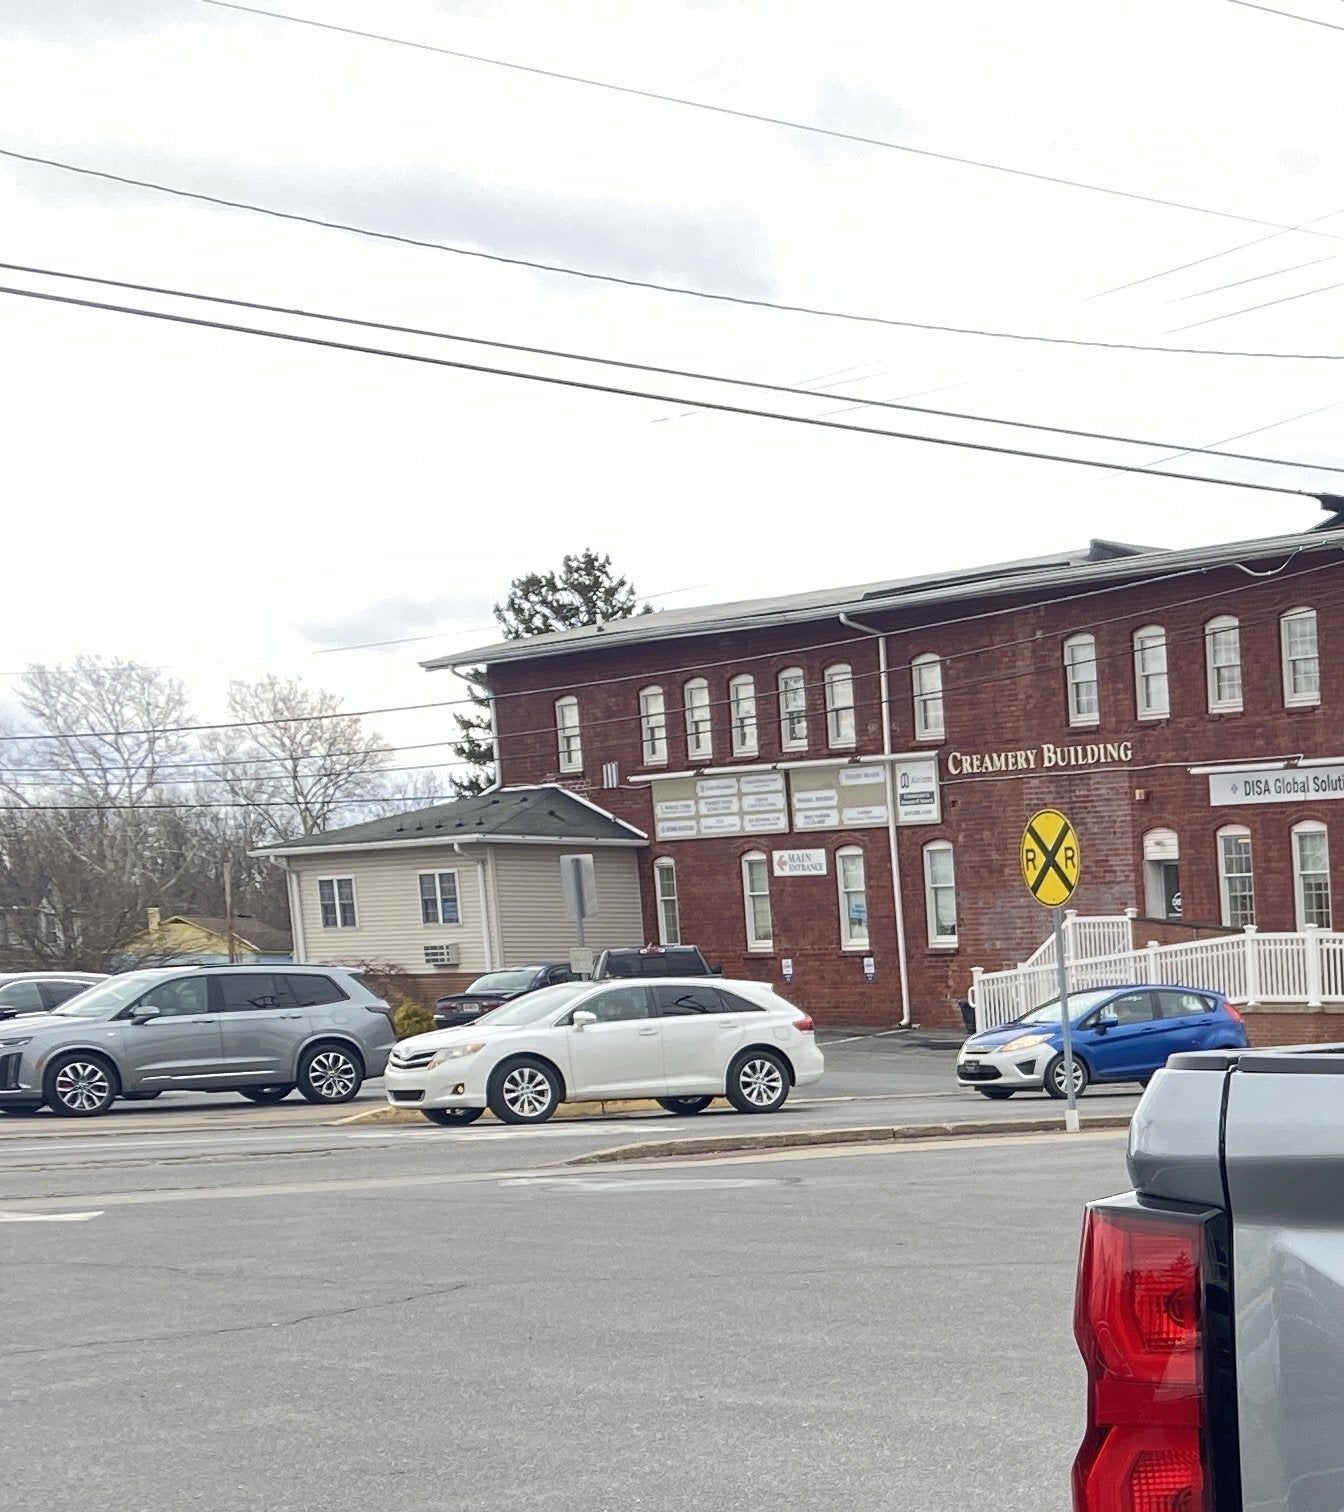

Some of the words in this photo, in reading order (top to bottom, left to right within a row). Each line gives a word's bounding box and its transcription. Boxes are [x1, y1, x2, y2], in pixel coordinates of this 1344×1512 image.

[948, 749, 1037, 775] CREAMERY
[1042, 742, 1133, 767] BUILDING
[1243, 778, 1271, 797] DISA
[1274, 776, 1310, 794] Global
[788, 853, 812, 863] MAIN
[788, 862, 824, 872] ENTRANCE
